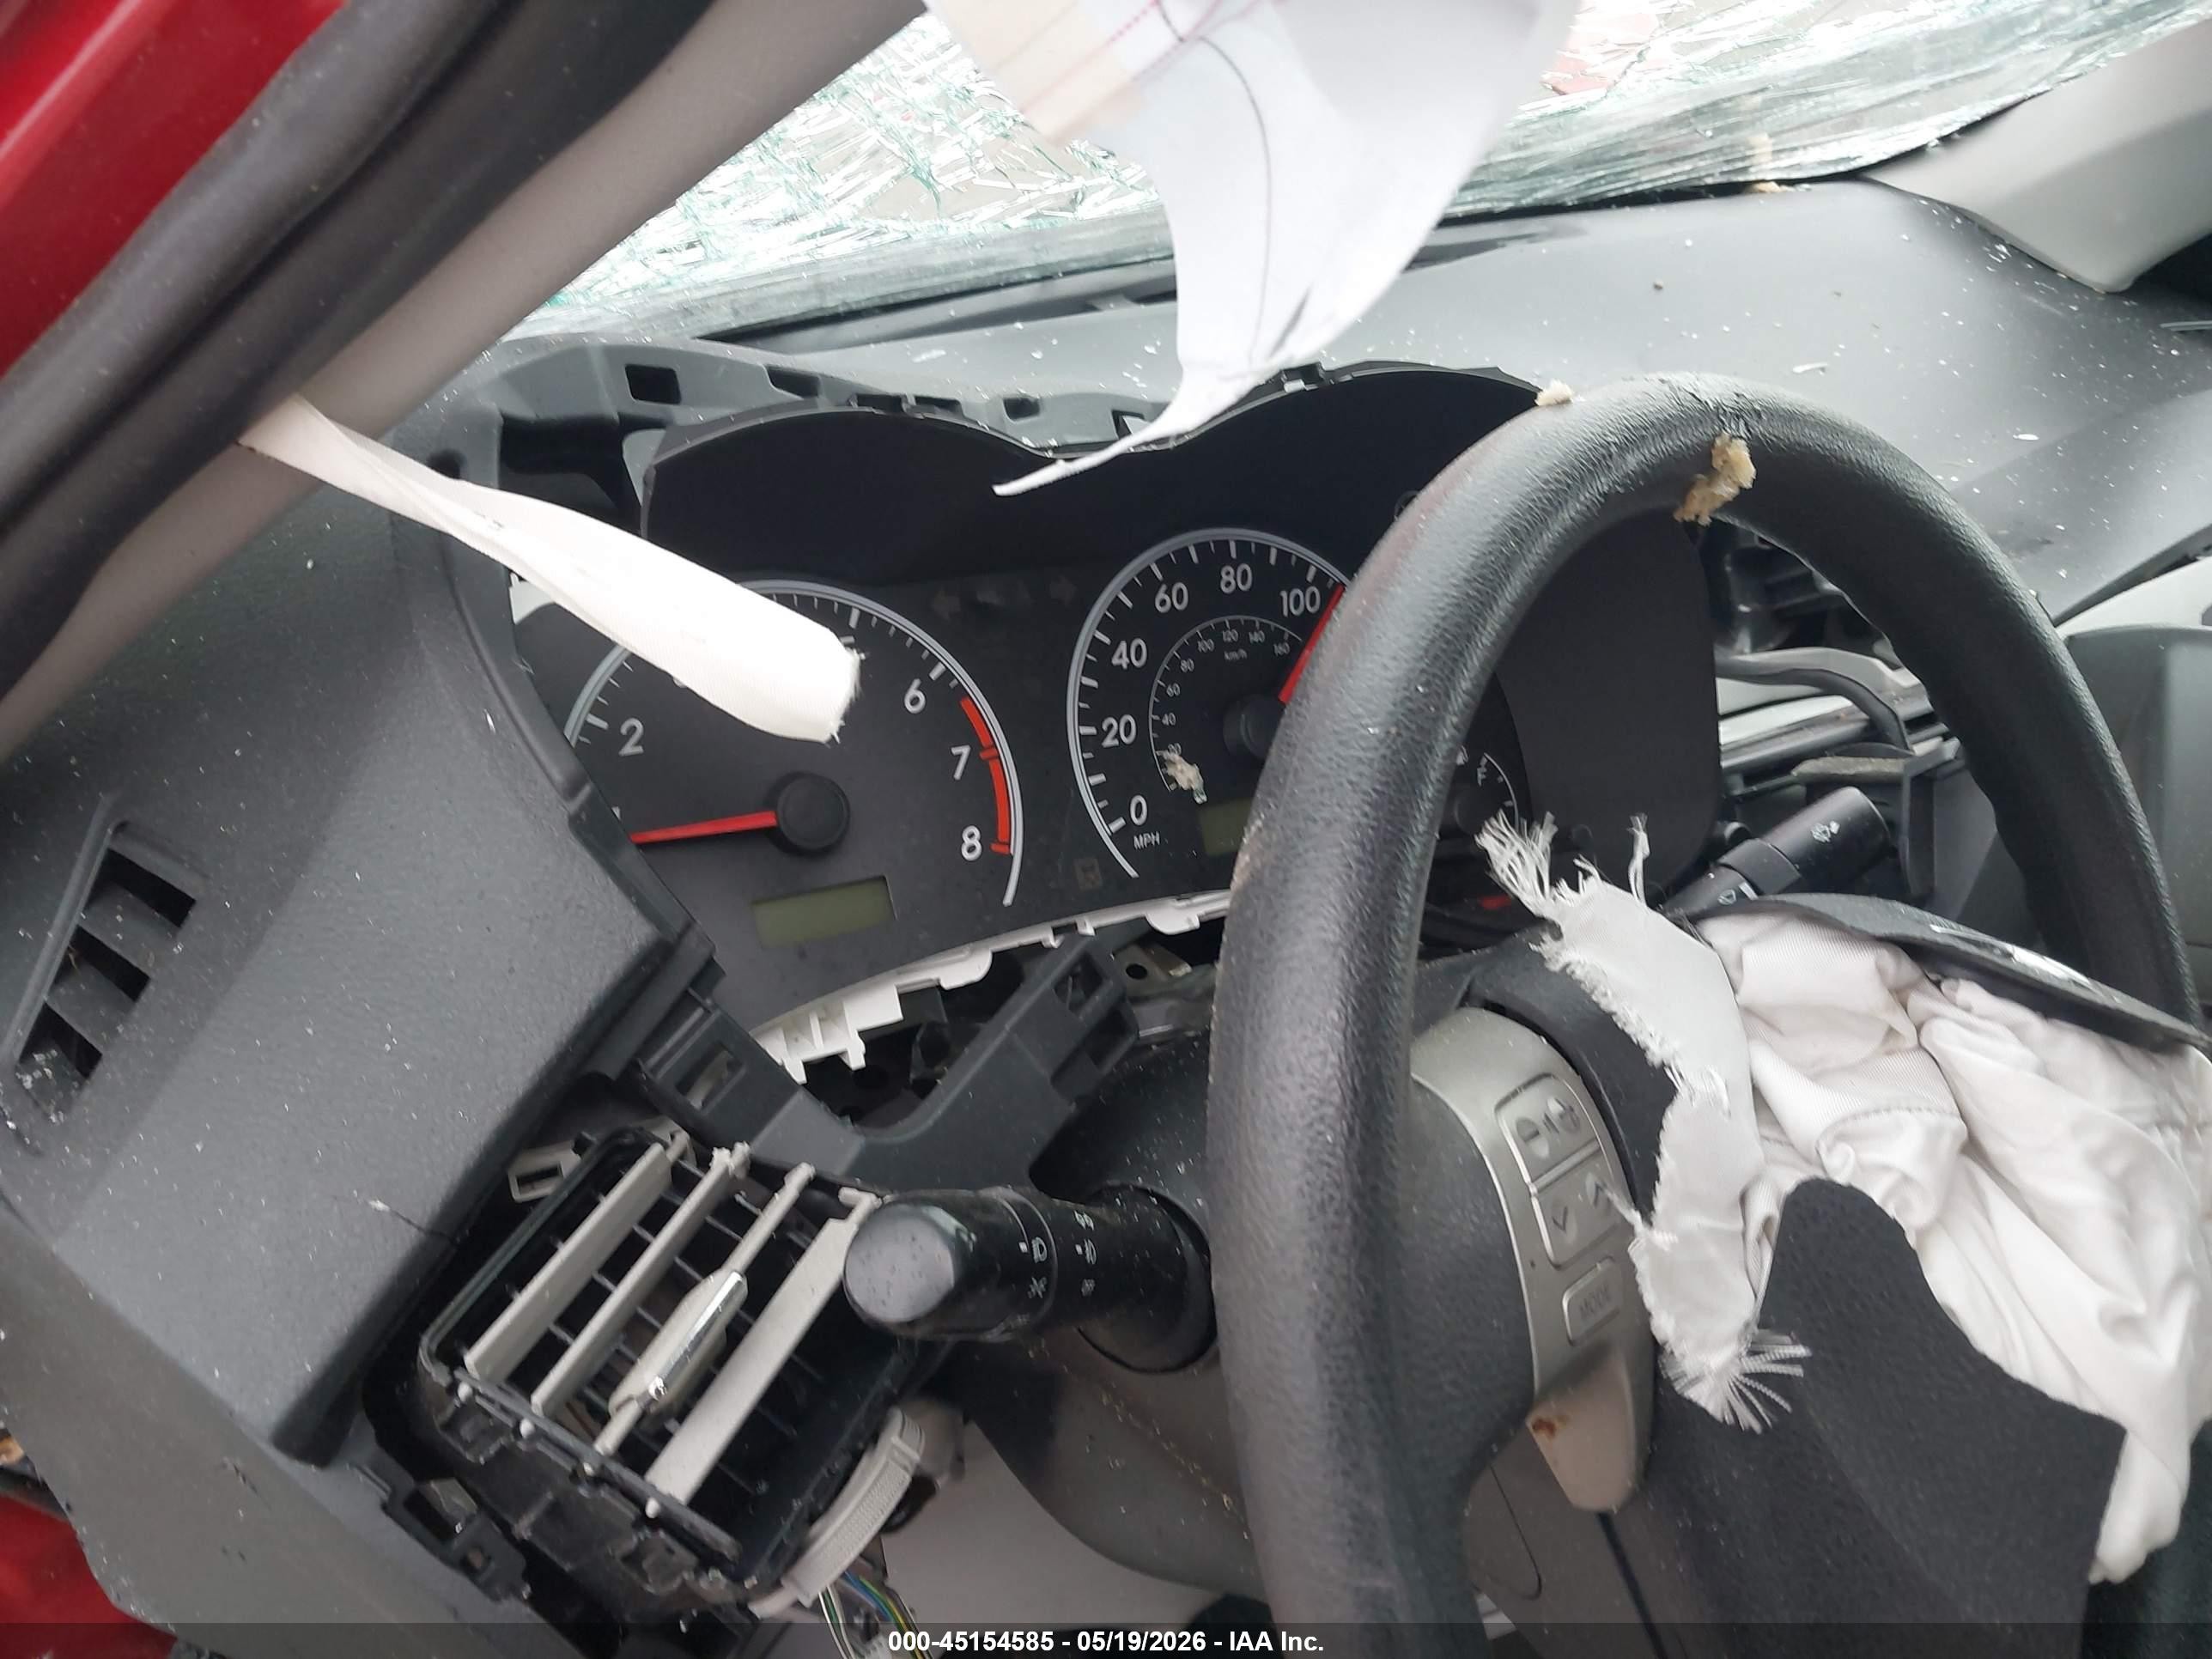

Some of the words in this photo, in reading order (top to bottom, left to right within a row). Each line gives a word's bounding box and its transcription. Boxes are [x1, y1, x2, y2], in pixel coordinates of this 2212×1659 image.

[1219, 563, 1252, 593] 80
[1155, 582, 1188, 613] 60
[1280, 586, 1321, 617] 100
[1197, 639, 1214, 653] 100
[1222, 629, 1238, 642] 120
[1110, 638, 1147, 669] 40
[1181, 659, 1194, 672] 80
[903, 678, 927, 714] 6
[1166, 683, 1181, 697] 60
[1102, 714, 1136, 748] 20
[1162, 713, 1176, 726] 40
[619, 718, 644, 757] 2
[951, 745, 971, 780] 7
[1129, 795, 1148, 826] 0
[961, 825, 982, 861] 8
[1133, 830, 1160, 850] MPH
